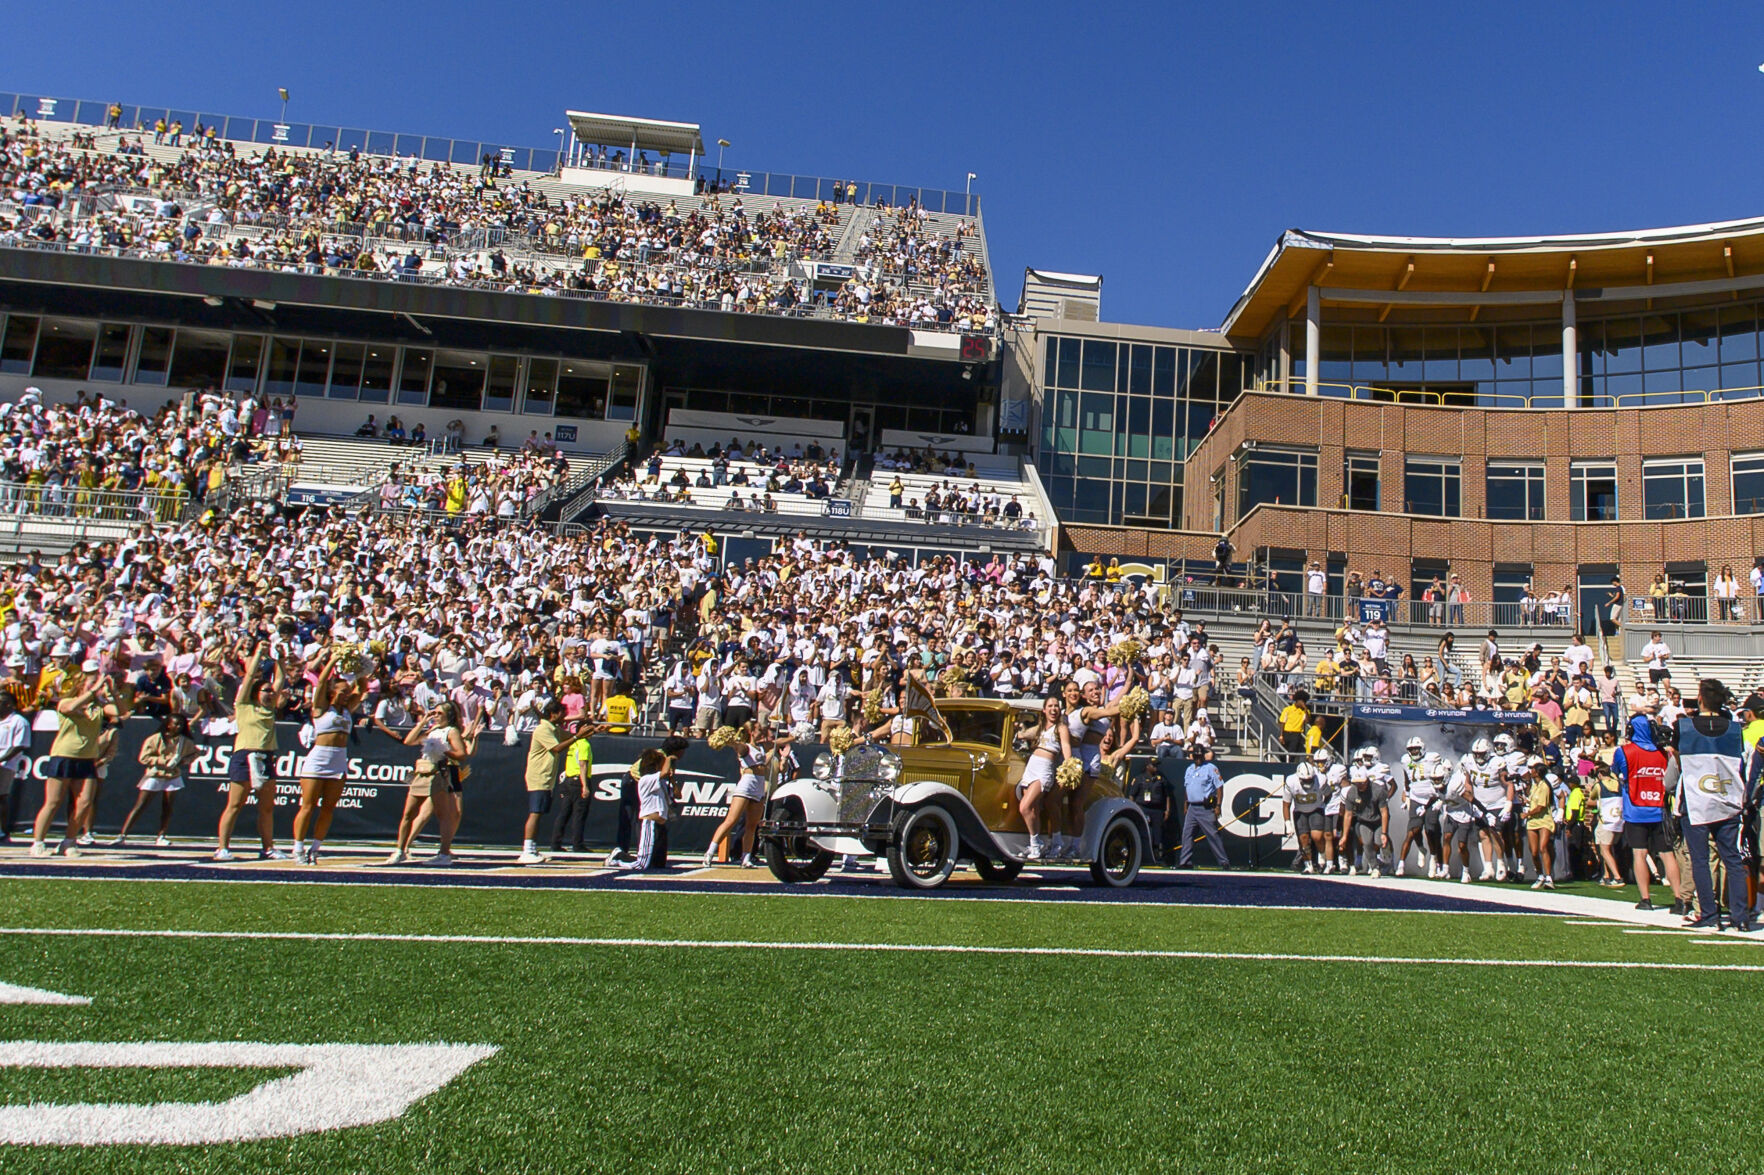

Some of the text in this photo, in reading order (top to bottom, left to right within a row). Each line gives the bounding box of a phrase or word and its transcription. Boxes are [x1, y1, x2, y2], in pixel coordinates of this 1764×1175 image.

[963, 338, 985, 360] 25
[302, 494, 316, 503] 116
[831, 507, 850, 516] 118U
[1365, 610, 1381, 620] 119
[1372, 707, 1402, 715] HYUNDAI
[1640, 790, 1661, 801] 052
[681, 806, 729, 818] ENERG
